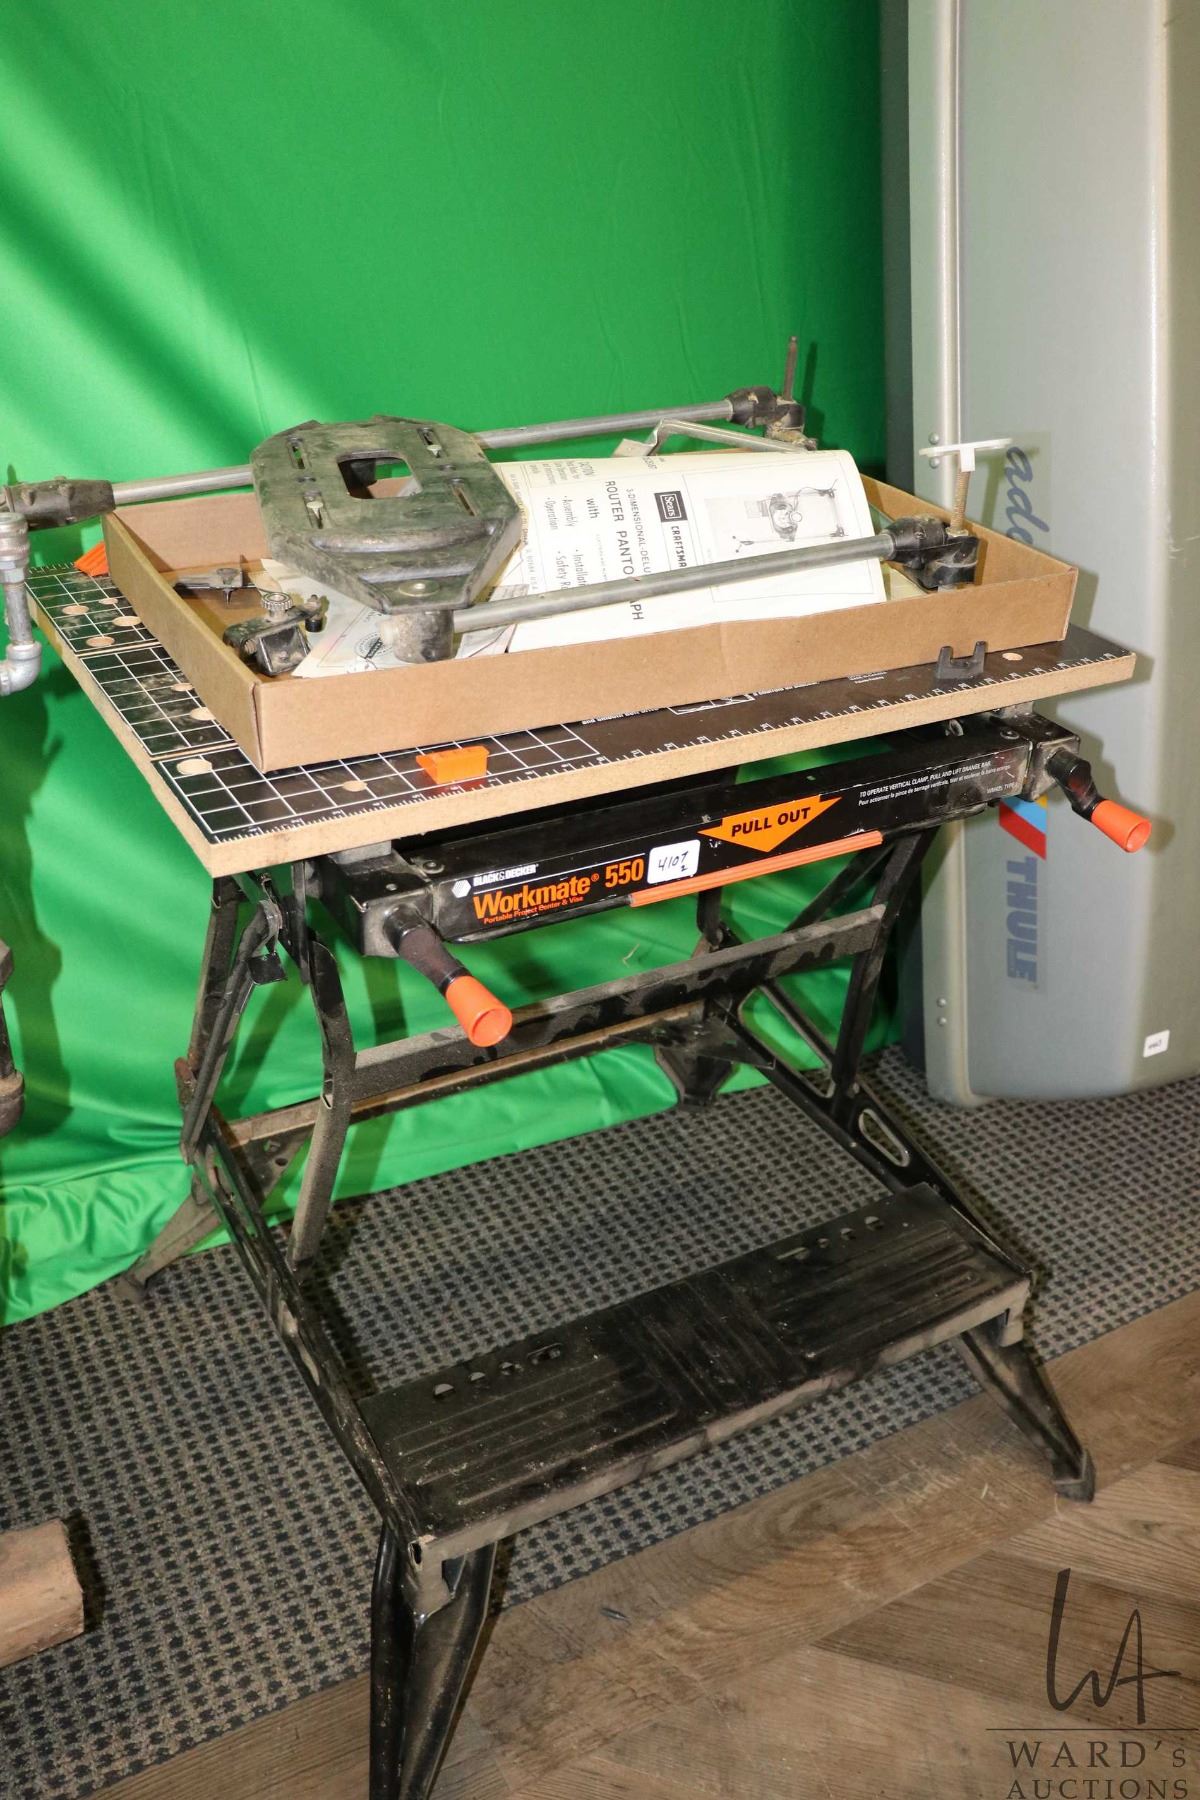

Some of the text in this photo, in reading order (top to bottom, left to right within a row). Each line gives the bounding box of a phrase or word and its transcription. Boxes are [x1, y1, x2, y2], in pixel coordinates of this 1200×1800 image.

[562, 499, 577, 527] Assembly
[586, 498, 600, 518] with
[605, 480, 625, 522] ROUTER
[545, 500, 558, 530] Operation
[556, 555, 569, 579] Safety
[664, 495, 687, 568] Sears CRAFTSMA
[867, 786, 889, 796] OPERATE
[889, 780, 911, 791] VERTICAL
[962, 763, 981, 772] ORANGE
[731, 807, 811, 837] PULL OUT
[604, 858, 645, 888] 550
[658, 850, 689, 872] 4107
[484, 912, 512, 924] Portable
[514, 906, 538, 917] Project
[570, 896, 584, 904] Vise
[1006, 856, 1038, 983] THULE
